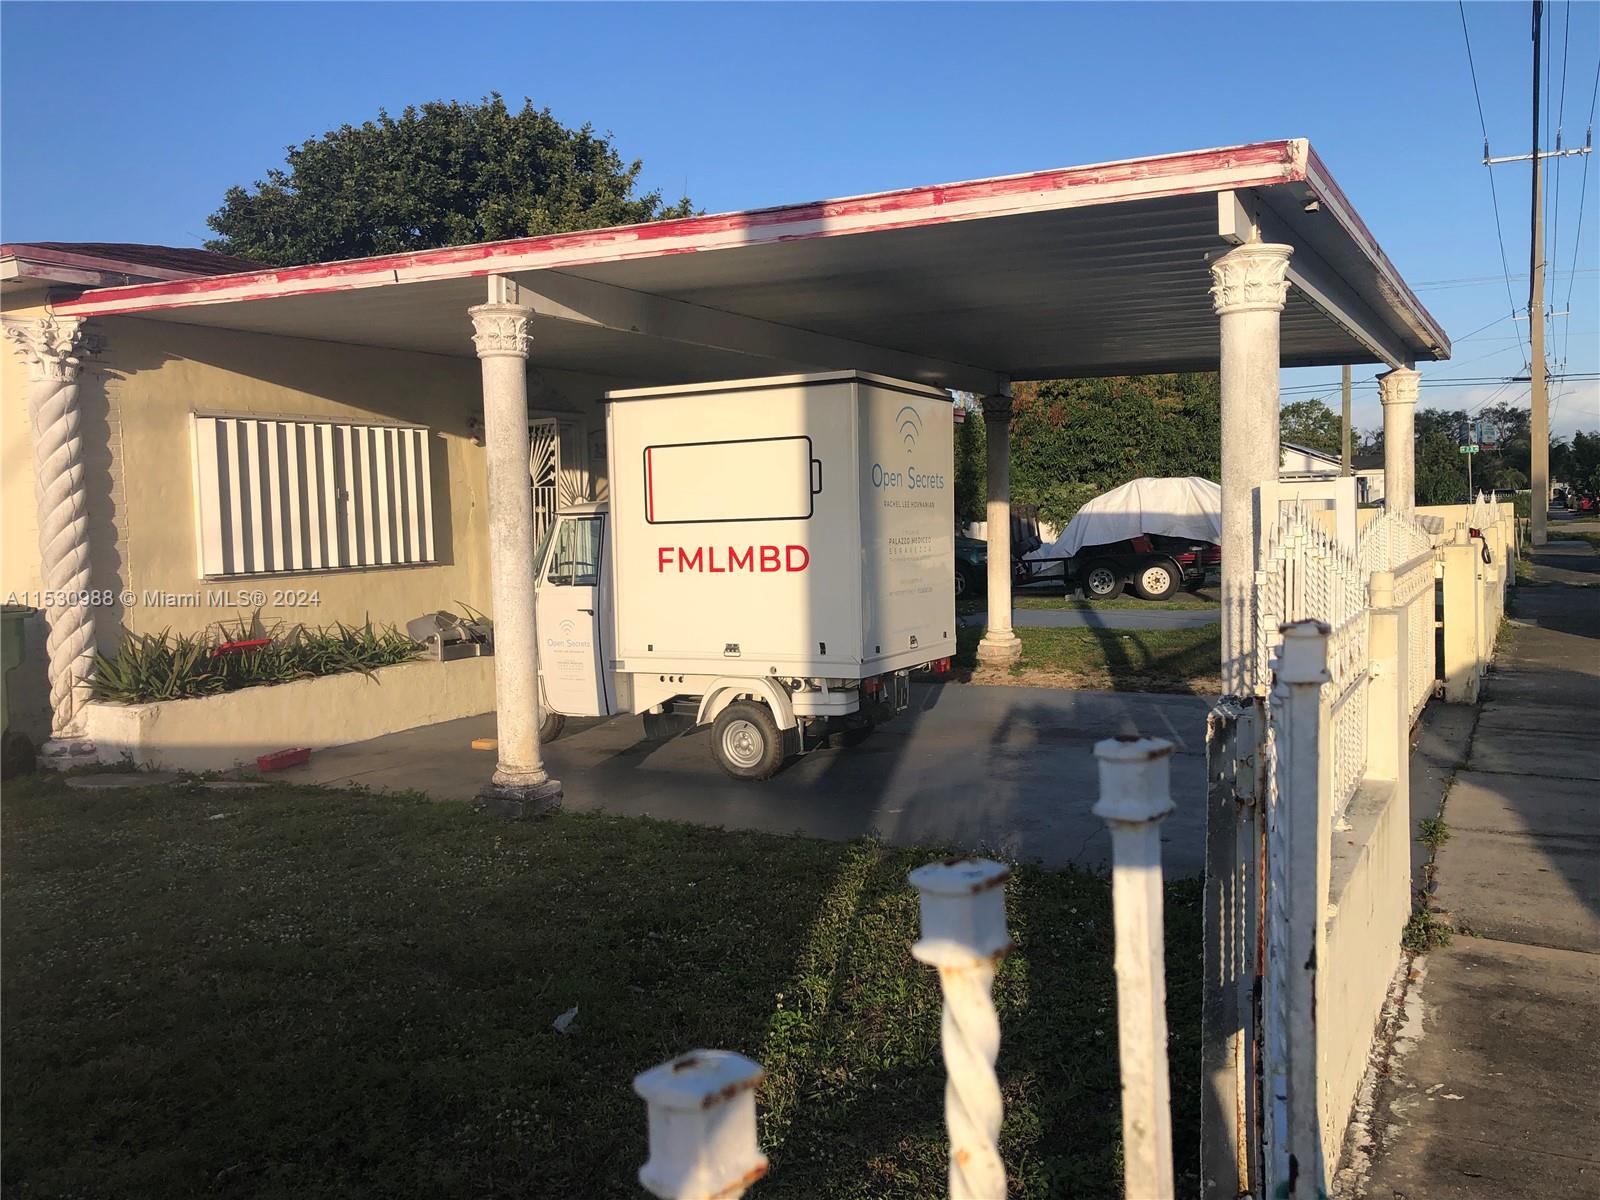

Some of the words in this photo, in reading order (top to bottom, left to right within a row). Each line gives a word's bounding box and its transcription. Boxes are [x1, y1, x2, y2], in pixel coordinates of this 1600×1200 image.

[872, 463, 903, 492] Open
[908, 466, 945, 489] Secrets
[658, 545, 810, 573] FMLMBD
[547, 638, 565, 648] Open
[567, 639, 591, 648] Secrets
